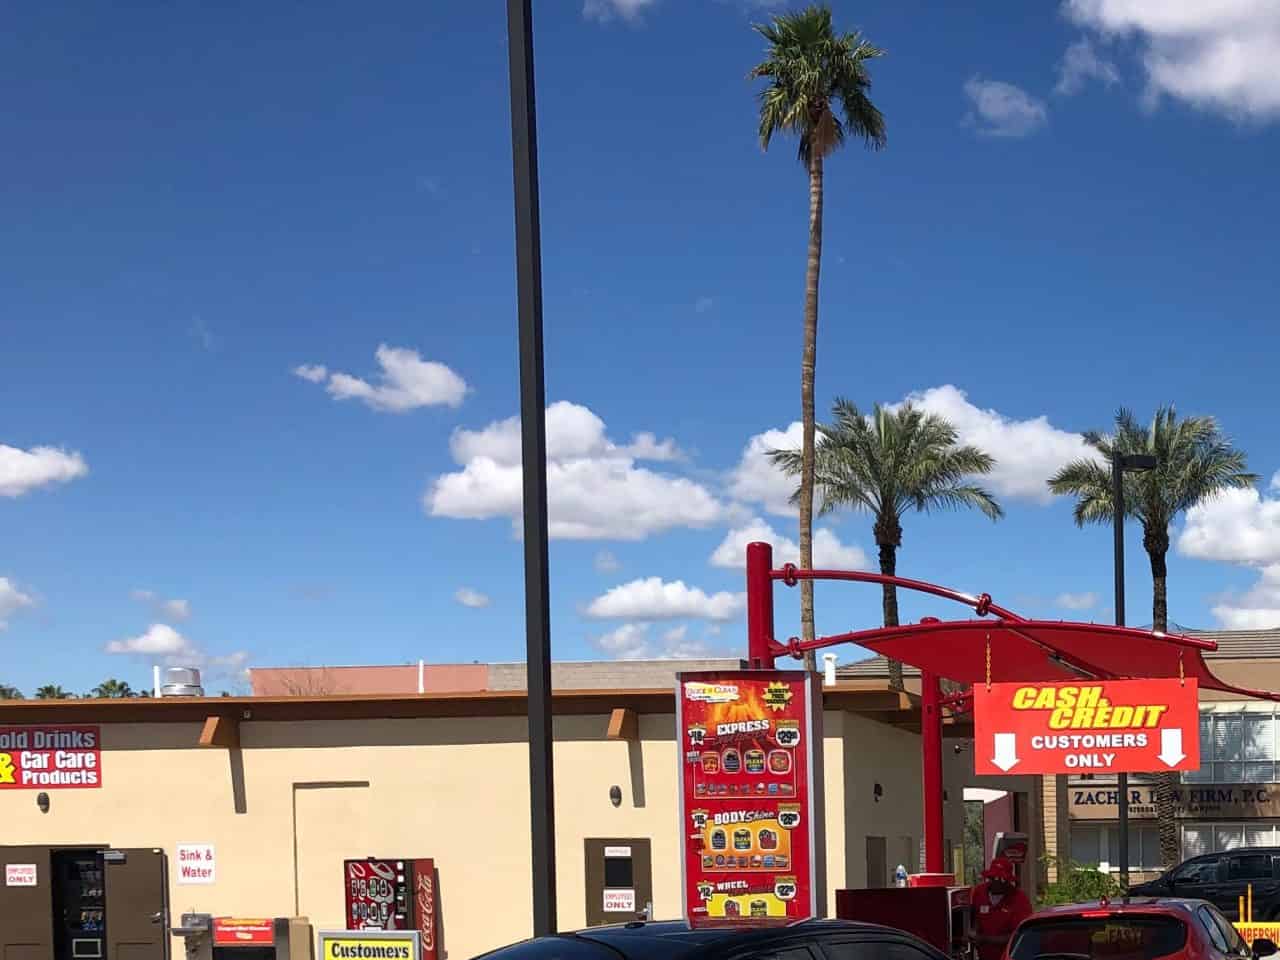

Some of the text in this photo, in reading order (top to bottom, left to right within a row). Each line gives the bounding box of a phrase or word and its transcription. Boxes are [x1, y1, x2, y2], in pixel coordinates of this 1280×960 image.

[1012, 686, 1102, 709] CASH
[1049, 705, 1168, 729] CREDIT
[717, 720, 770, 736] EXPRESS
[0, 731, 95, 749] old Drinks
[1031, 734, 1147, 749] CUSTOMERS
[21, 751, 49, 768] Car
[55, 750, 96, 768] Care
[1065, 753, 1116, 767] ONLY
[22, 770, 97, 784] Products
[1074, 791, 1146, 805] ZACHR
[714, 811, 746, 825] BODY
[180, 849, 213, 861] Sink &
[181, 866, 212, 878] Water
[717, 880, 749, 891] WHEEL
[332, 943, 409, 958] Customers
